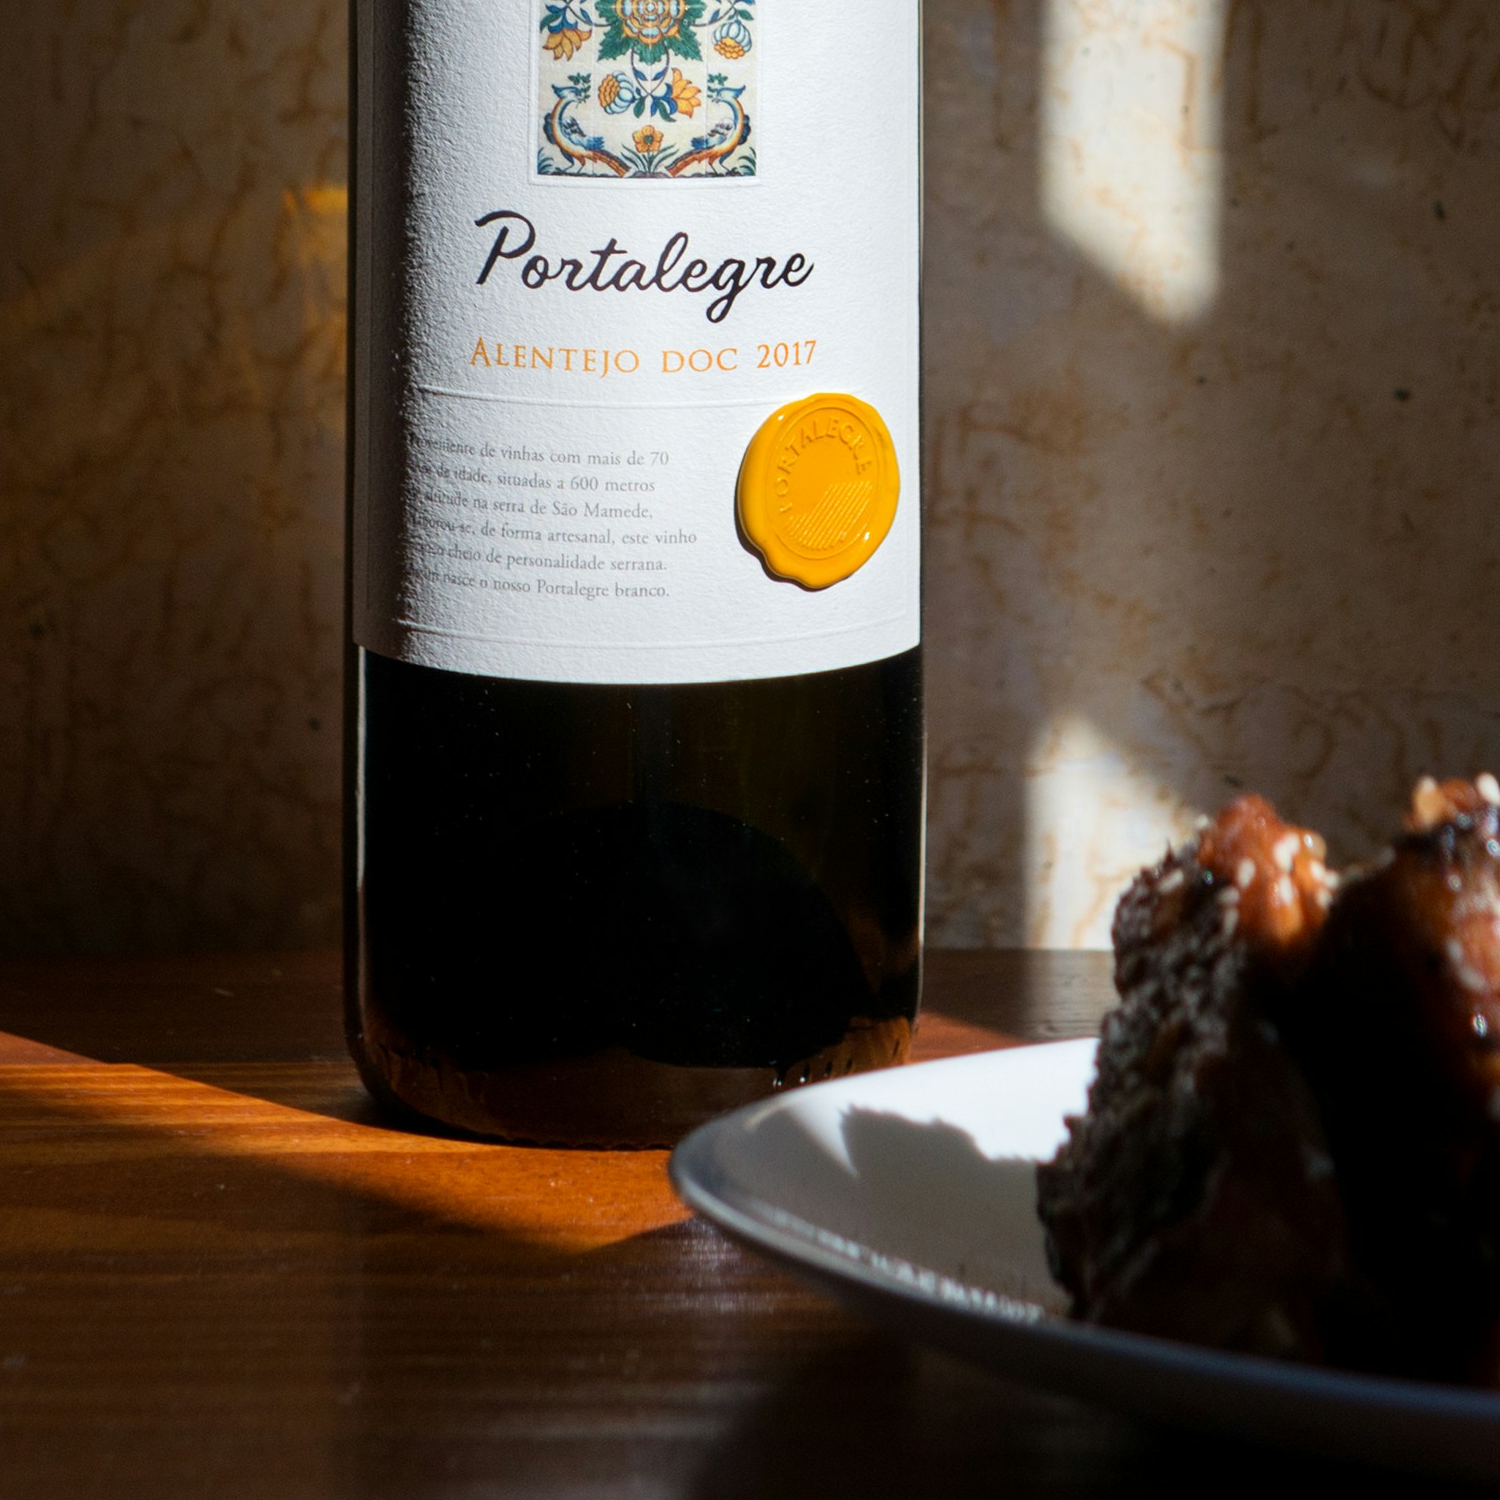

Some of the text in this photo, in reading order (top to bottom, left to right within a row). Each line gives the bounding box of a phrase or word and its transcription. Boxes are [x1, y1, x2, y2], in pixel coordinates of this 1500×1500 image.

[473, 209, 815, 324] Portalegre
[468, 335, 818, 379] ALENTEJO DOC 2017
[480, 441, 497, 458] de
[501, 445, 545, 463] vinhas
[550, 451, 581, 465] com
[587, 451, 621, 466] mais
[626, 450, 645, 466] de
[650, 451, 670, 466] 70
[775, 415, 873, 515] PORTALEGRE
[454, 465, 492, 485] idade,
[497, 471, 552, 490] situadas
[556, 479, 565, 491] a
[569, 475, 599, 492] 600
[604, 478, 656, 493] metros
[472, 497, 489, 511] na
[493, 501, 525, 515] serra
[530, 499, 547, 516] de
[551, 499, 578, 517] São
[583, 501, 654, 520] Mamede,
[480, 519, 497, 537] de
[501, 522, 543, 543] forma
[547, 528, 617, 546] artesanal,
[621, 532, 649, 545] este
[654, 527, 698, 545] vinho
[486, 547, 501, 564] de
[506, 553, 606, 571] personalidade
[610, 558, 668, 572] serrana.
[479, 578, 488, 590] o
[493, 579, 531, 594] nosso
[536, 577, 610, 601] Portalegre
[614, 581, 671, 598] branco.
